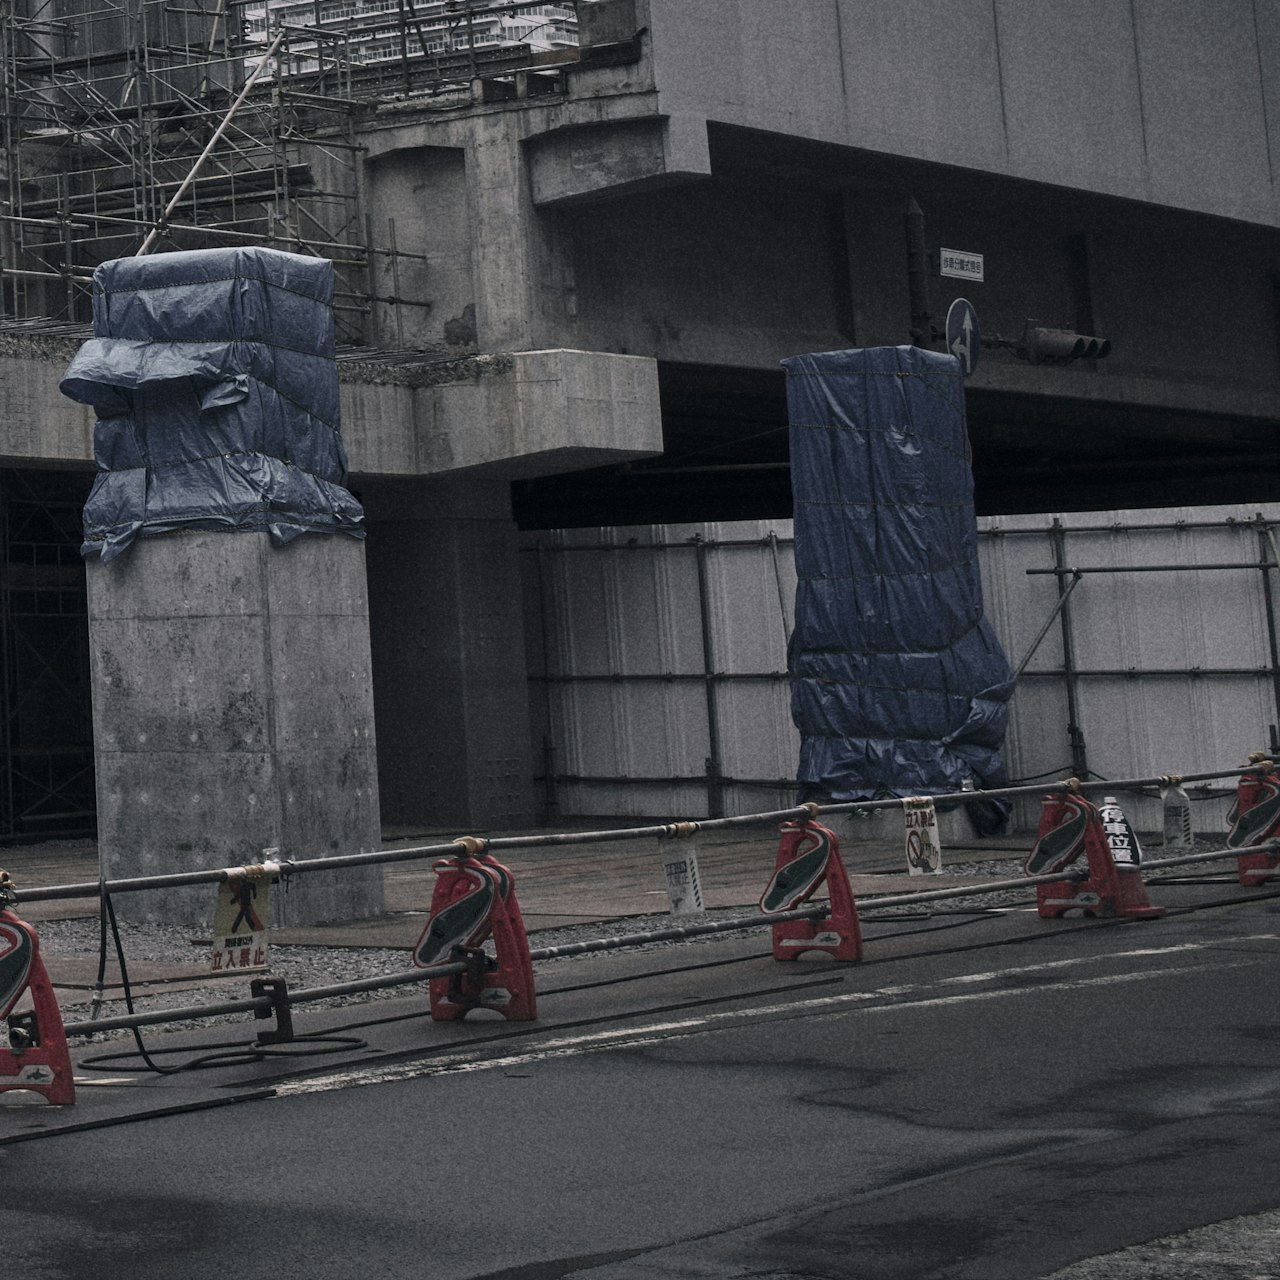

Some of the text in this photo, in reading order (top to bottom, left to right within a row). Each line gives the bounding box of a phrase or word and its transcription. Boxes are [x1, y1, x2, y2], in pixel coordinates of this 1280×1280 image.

[905, 809, 935, 829] 立入禁止
[1101, 809, 1134, 863] 停車位置
[212, 946, 265, 971] 立入禁止
